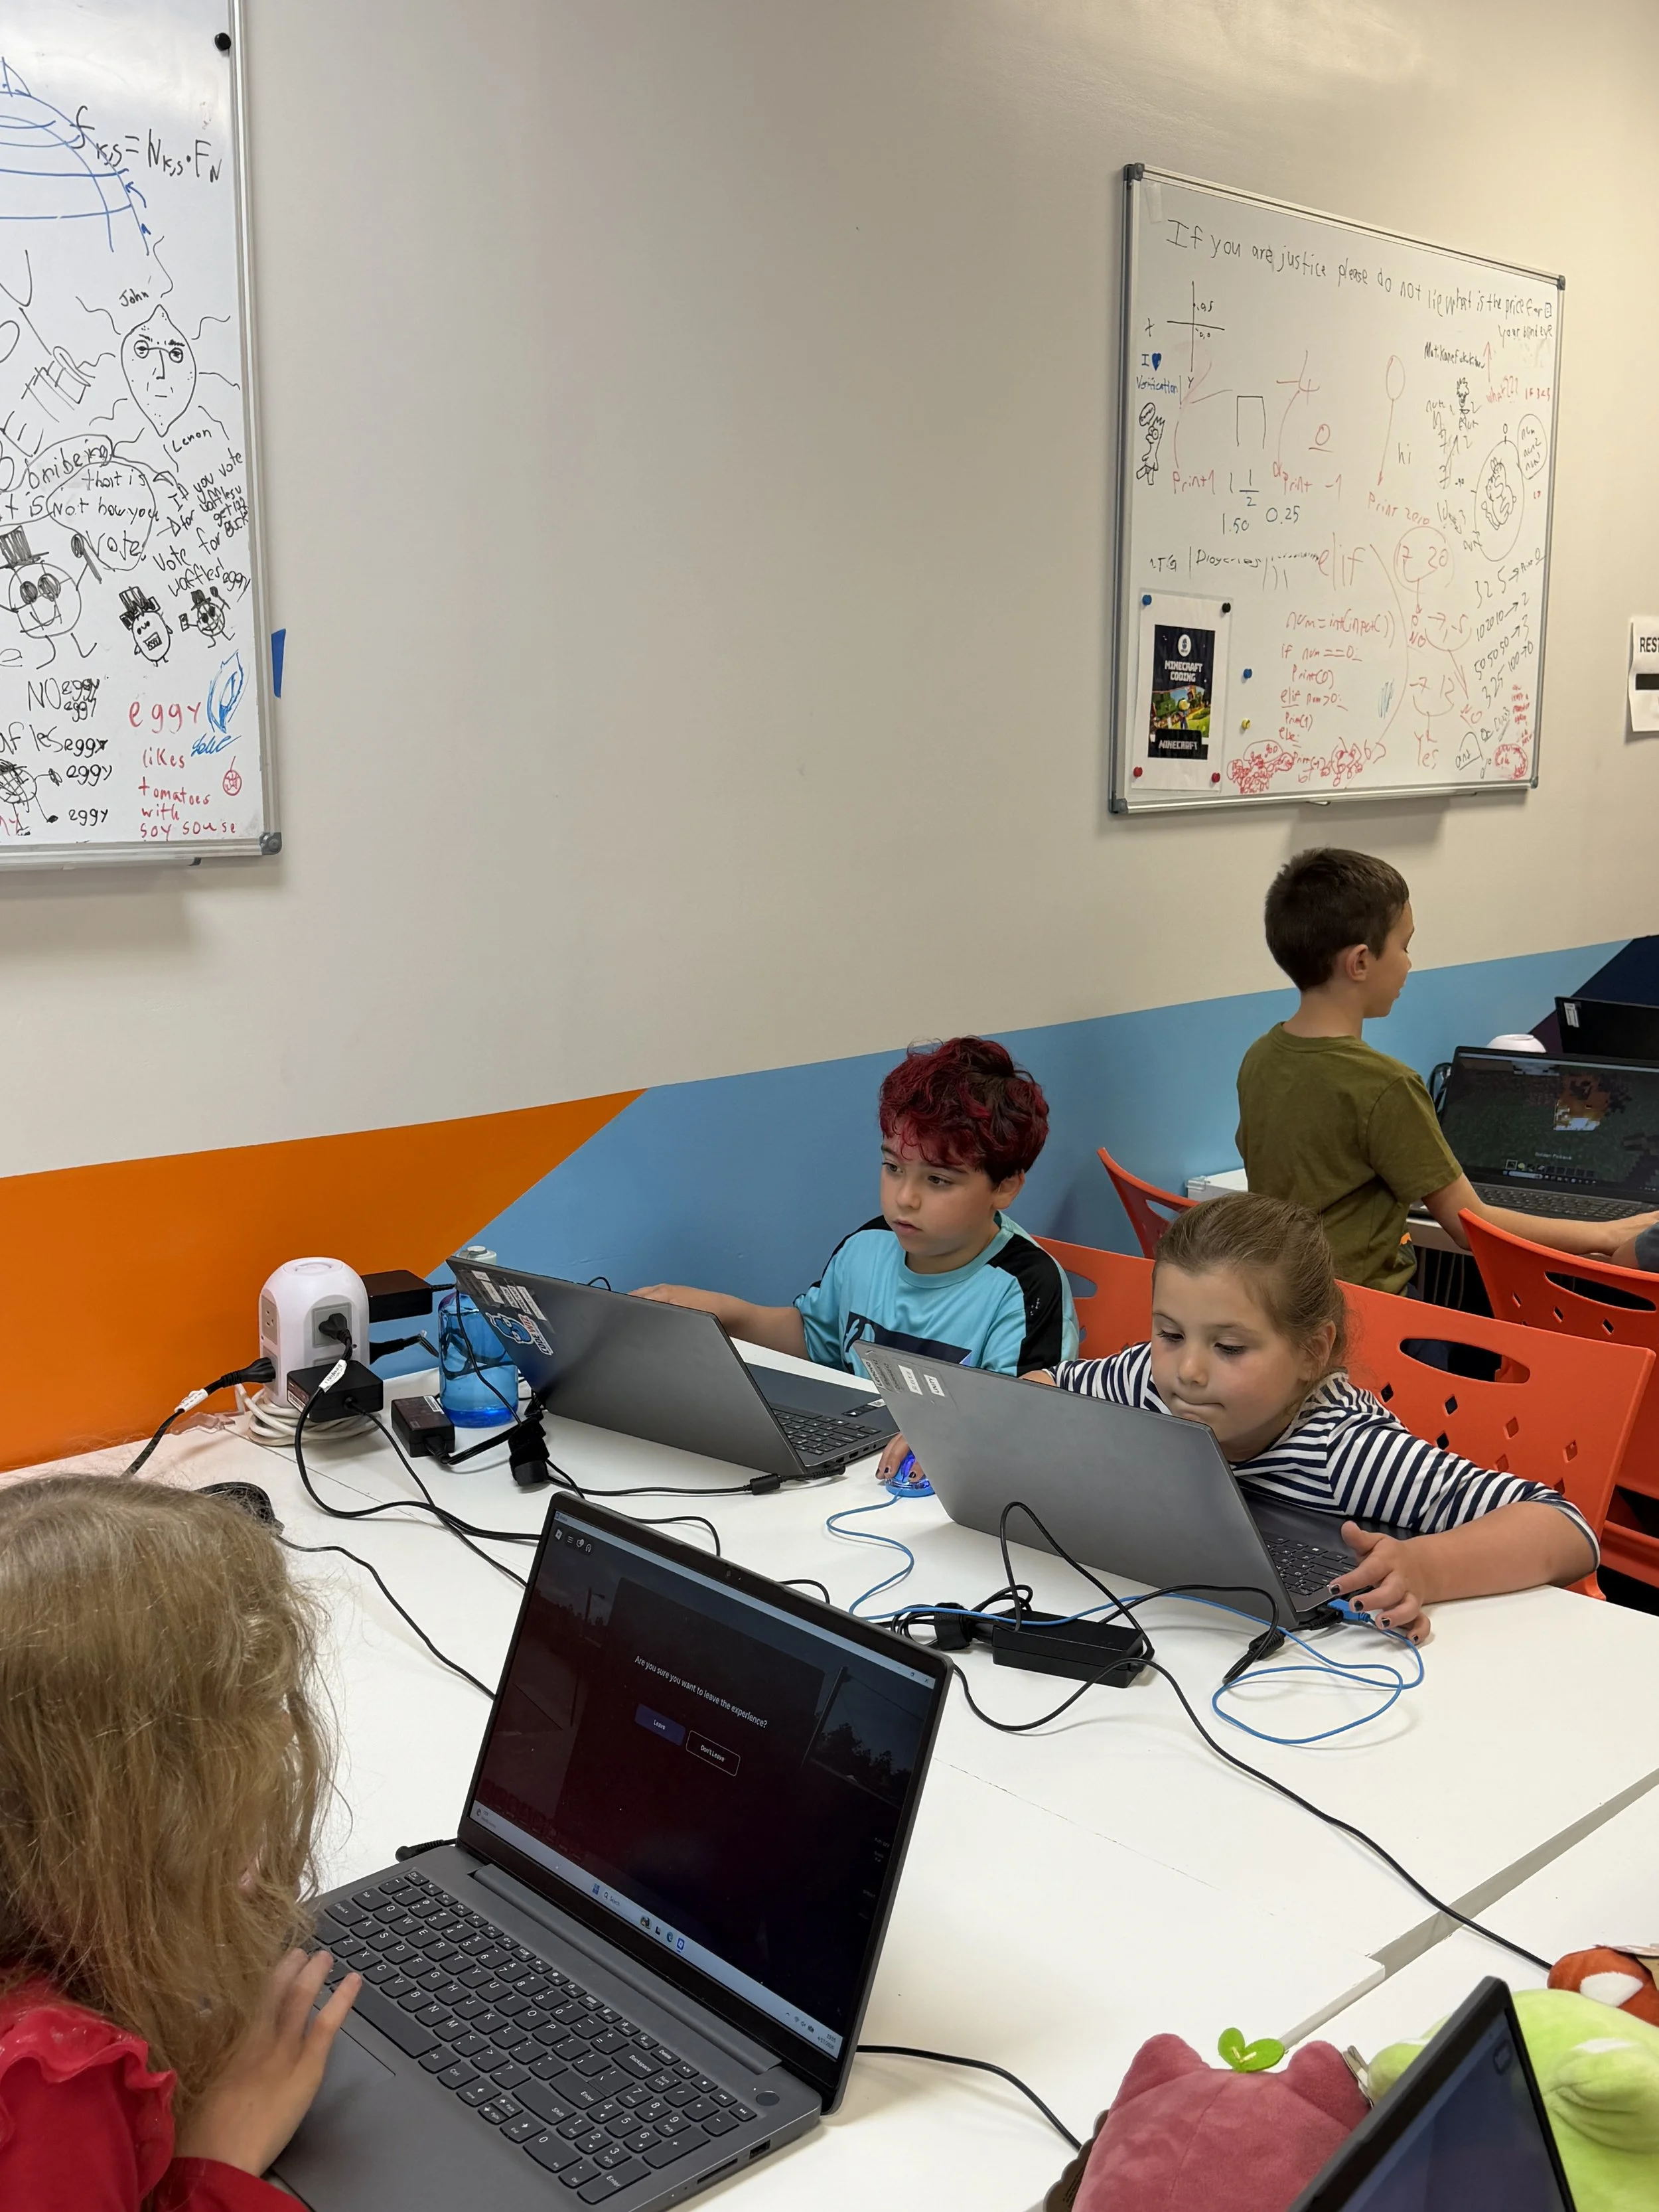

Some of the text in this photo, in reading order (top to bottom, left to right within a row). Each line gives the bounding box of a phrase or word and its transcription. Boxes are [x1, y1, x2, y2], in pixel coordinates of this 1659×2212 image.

[1166, 219, 1203, 250] If
[1210, 234, 1240, 258] you
[1276, 245, 1327, 277] justice
[1338, 258, 1368, 287] please
[1377, 267, 1392, 293] do
[1400, 281, 1421, 301] not
[119, 288, 149, 307] John
[1398, 442, 1411, 465] hi
[129, 469, 147, 486] is
[192, 473, 214, 505] you
[218, 447, 243, 477] vote
[1265, 505, 1301, 525] 0.25
[196, 526, 220, 555] for
[1164, 660, 1204, 673] MINECRAFT
[1169, 670, 1196, 683] CODING
[27, 677, 62, 712] NO
[128, 700, 202, 735] eggy
[1158, 739, 1198, 751] MINECRAFT
[143, 747, 185, 769] likes
[66, 764, 113, 787] eggy
[137, 776, 211, 806] tomatoes
[68, 808, 109, 827] eggy
[141, 803, 180, 821] with
[140, 822, 172, 842] soy
[634, 1655, 768, 1729] Are you sure you want to leave the experience?
[653, 1719, 666, 1731] Leave
[711, 1750, 725, 1763] Leave
[428, 2004, 440, 2013] N
[446, 2020, 459, 2028] M
[580, 2089, 595, 2103] Enter
[606, 2175, 621, 2187] Enter
